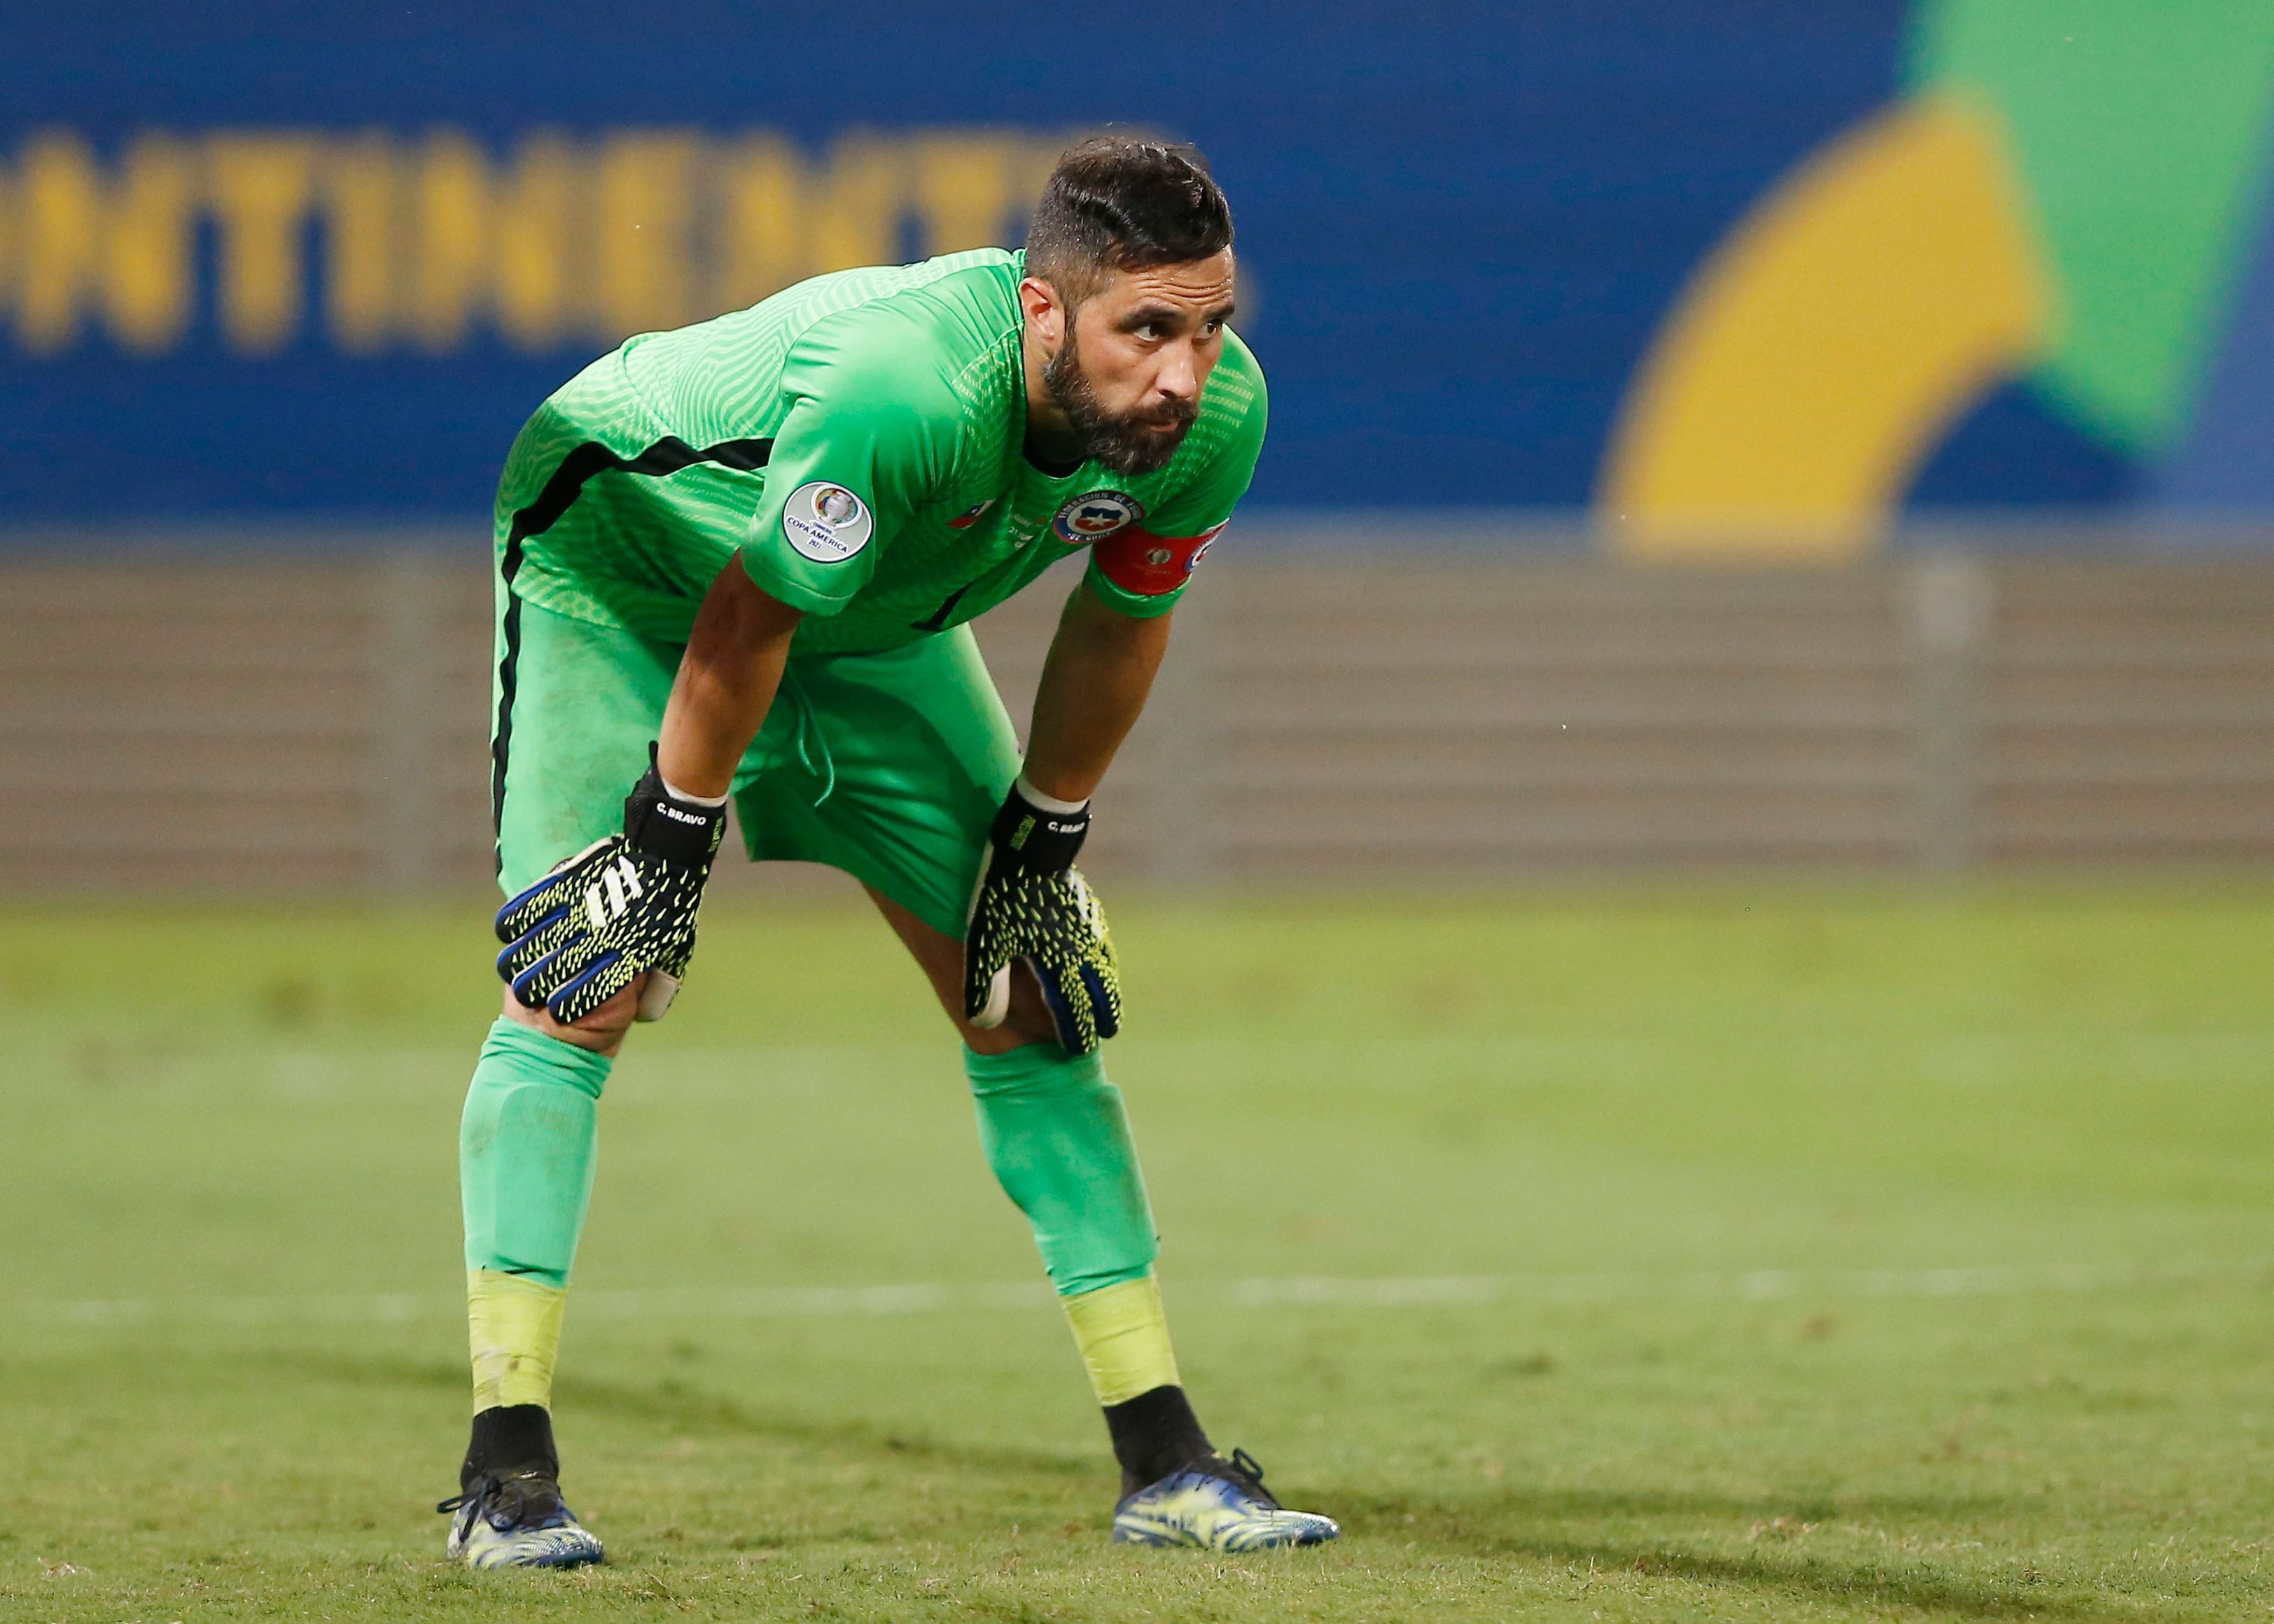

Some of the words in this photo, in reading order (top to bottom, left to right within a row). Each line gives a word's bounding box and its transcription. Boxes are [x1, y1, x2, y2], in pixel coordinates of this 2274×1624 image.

[0, 123, 1257, 354] NTINENT
[787, 517, 809, 533] COPA
[810, 530, 847, 553] AMERICA
[656, 802, 667, 816] C.
[667, 807, 706, 826] BRAVO
